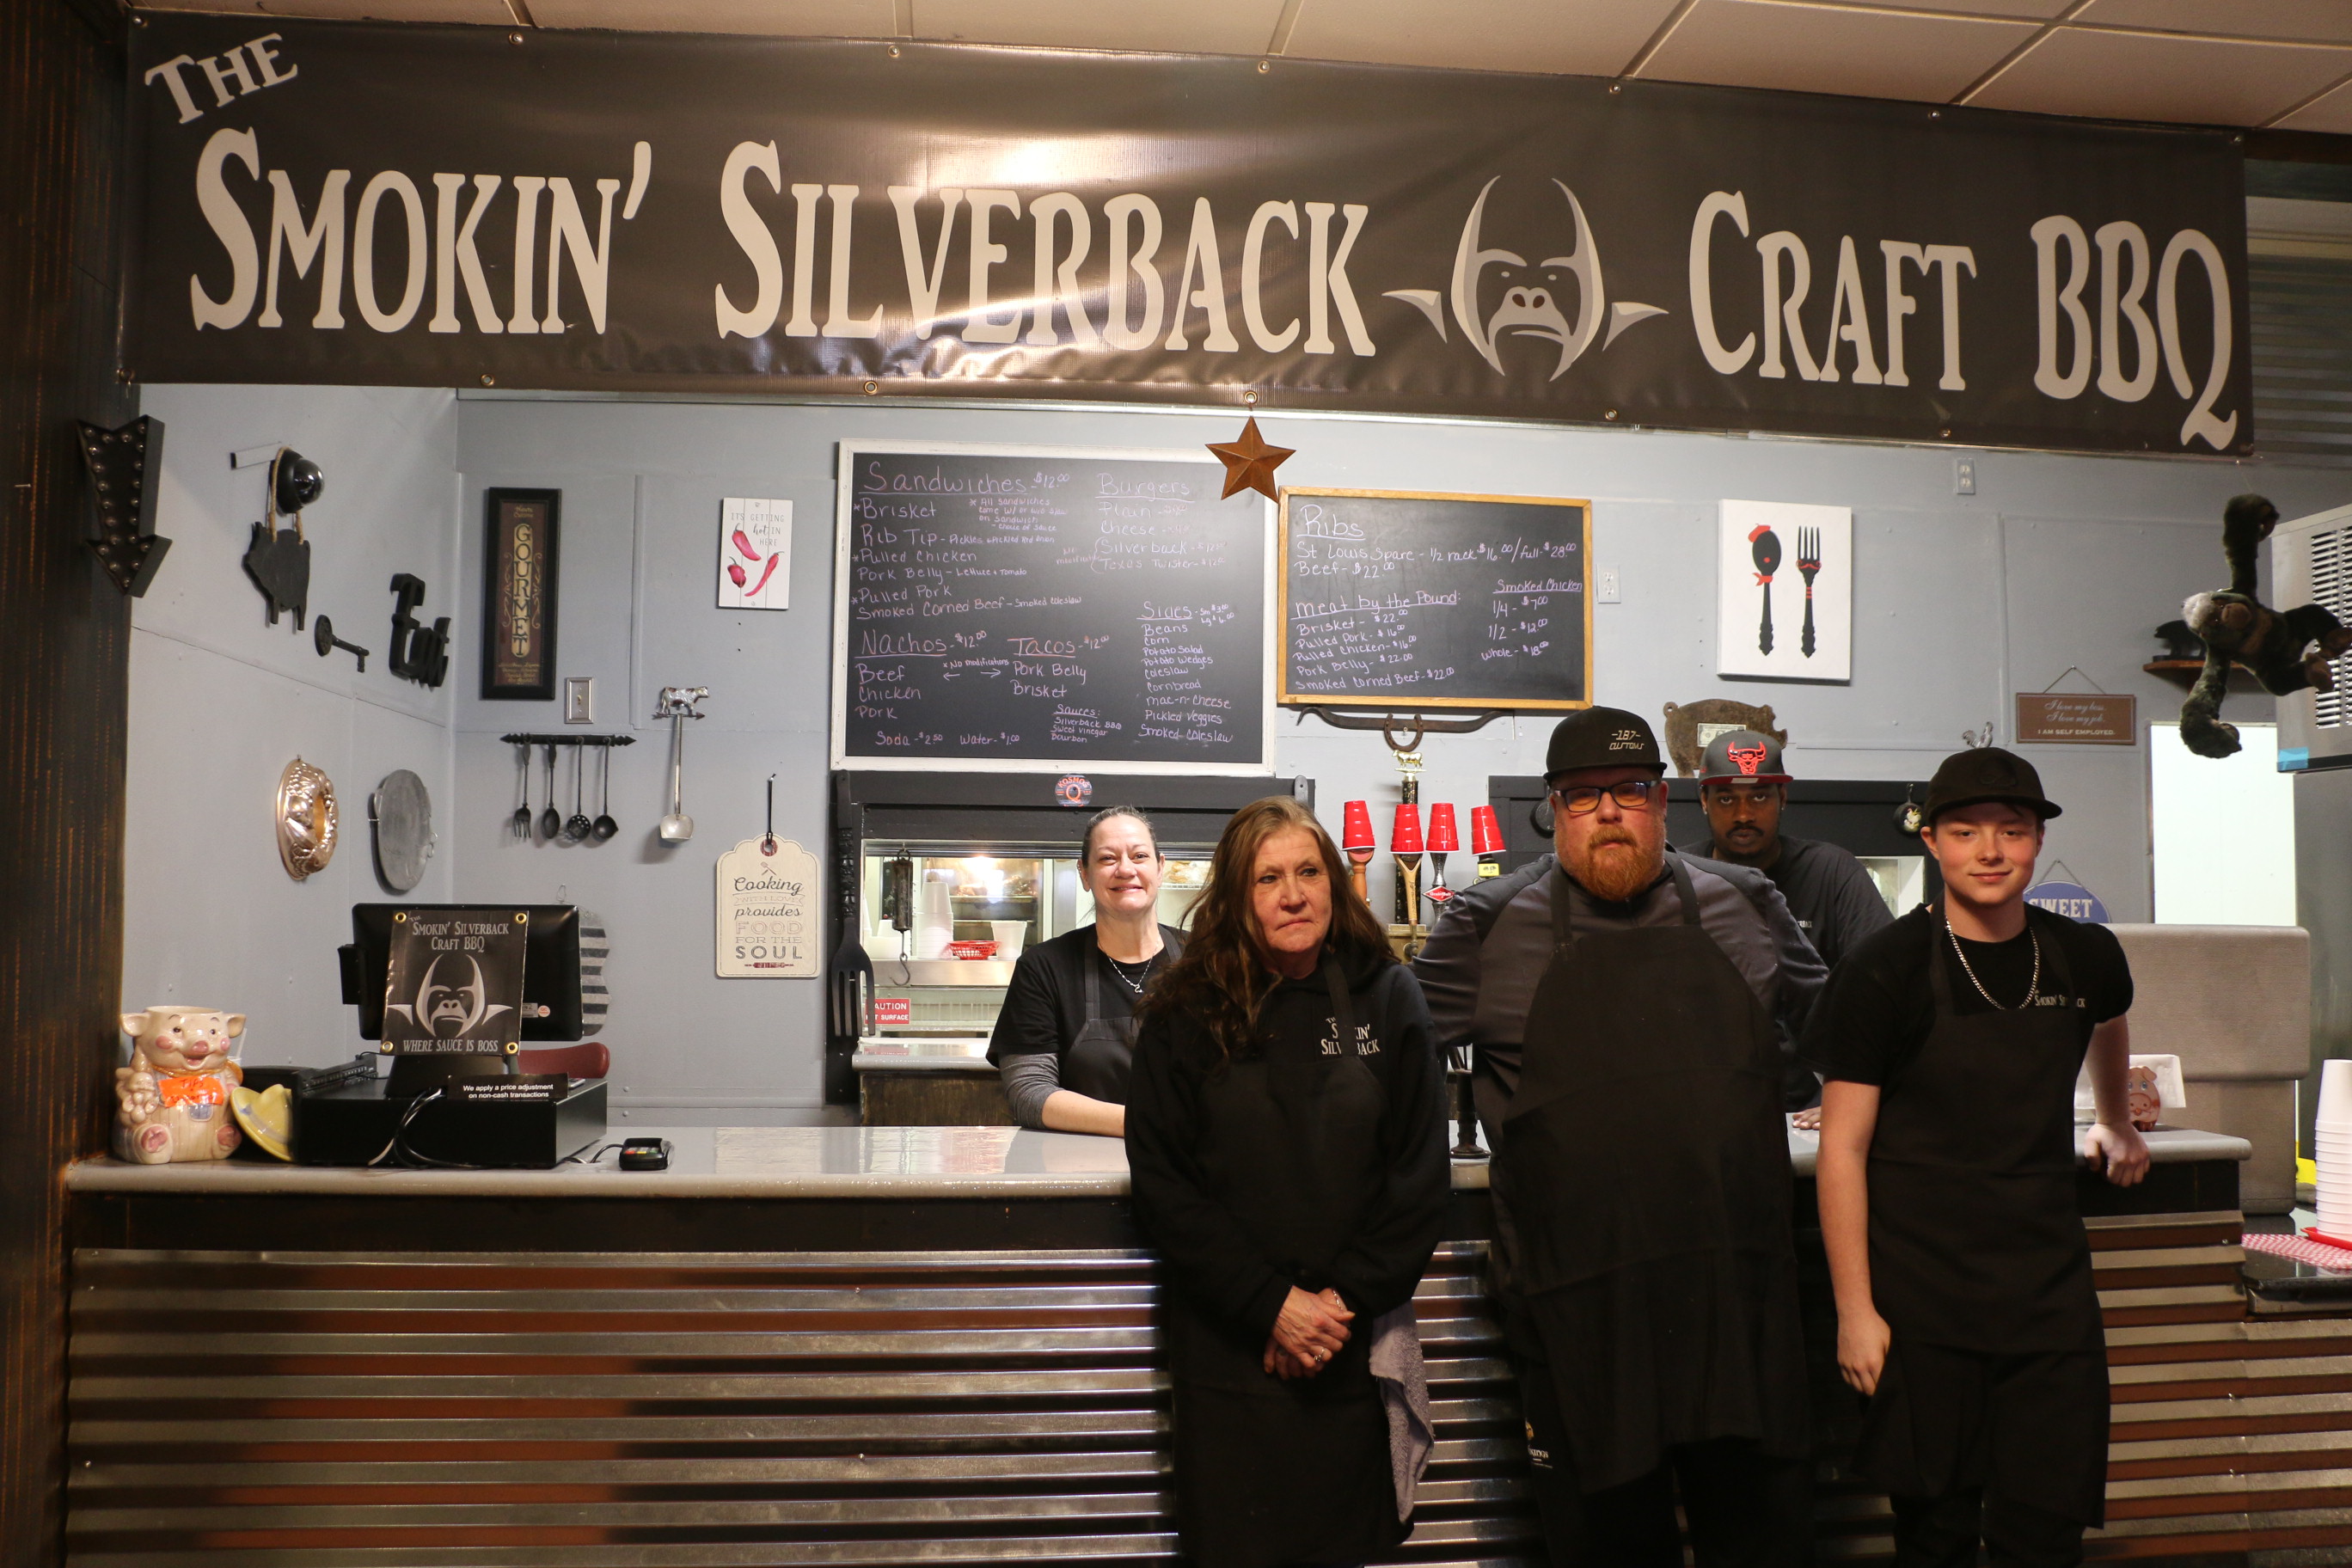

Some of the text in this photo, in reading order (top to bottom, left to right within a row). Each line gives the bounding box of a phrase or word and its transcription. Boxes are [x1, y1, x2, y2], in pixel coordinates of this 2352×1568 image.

[144, 33, 298, 124] THE
[190, 126, 2236, 450] SMOKIN' SILVERBACK CRAFT BBQ
[864, 462, 1027, 493] Sandwiches
[1097, 473, 1191, 501] Burgers
[861, 498, 937, 518] Brisket
[1099, 501, 1152, 518] Plain
[750, 513, 785, 522] GETTING
[1300, 504, 1364, 537] Ribs
[752, 523, 781, 536] hot IN
[861, 523, 897, 547] Rib
[903, 528, 937, 547] Tip
[759, 538, 777, 547] HERE
[860, 548, 906, 564] Pulled
[1296, 543, 1318, 559] St
[1328, 544, 1368, 560] Louis
[857, 567, 897, 582] Pork
[904, 567, 943, 585] Belly
[513, 524, 533, 658] GOURMET
[1498, 579, 1544, 591] Smoked
[858, 585, 952, 603] Pulled Pork
[856, 604, 915, 621] Smoked
[974, 596, 1005, 609] Beef
[1141, 601, 1193, 619] Sides
[1358, 594, 1381, 615] by
[1387, 592, 1411, 608] the
[1141, 623, 1188, 637] Beans
[1296, 617, 1355, 637] Brisket
[861, 629, 947, 655] Nachos
[1007, 637, 1075, 657] Tacos
[1295, 637, 1338, 650] Pulled
[1292, 648, 1334, 662] Pulled
[854, 664, 905, 684] Beef
[1014, 661, 1087, 685] Pork Belly
[1296, 664, 1327, 677] Pork
[1332, 659, 1369, 674] Belly
[1394, 670, 1420, 684] Beef
[1010, 680, 1067, 698] Brisket
[854, 706, 898, 720] Pork
[1144, 710, 1182, 722] Pickled
[875, 731, 911, 746] Soda
[734, 875, 804, 896] Cooking
[734, 905, 804, 921] provides
[454, 921, 509, 935] SILVERBACK
[735, 921, 803, 935] FOOD
[432, 935, 485, 952] CRAFT BBQ
[735, 945, 803, 959] SOUL
[403, 1038, 499, 1052] WHERE SAUCE IS BOSS
[475, 1085, 493, 1093] apply
[518, 1083, 554, 1092] adjustment
